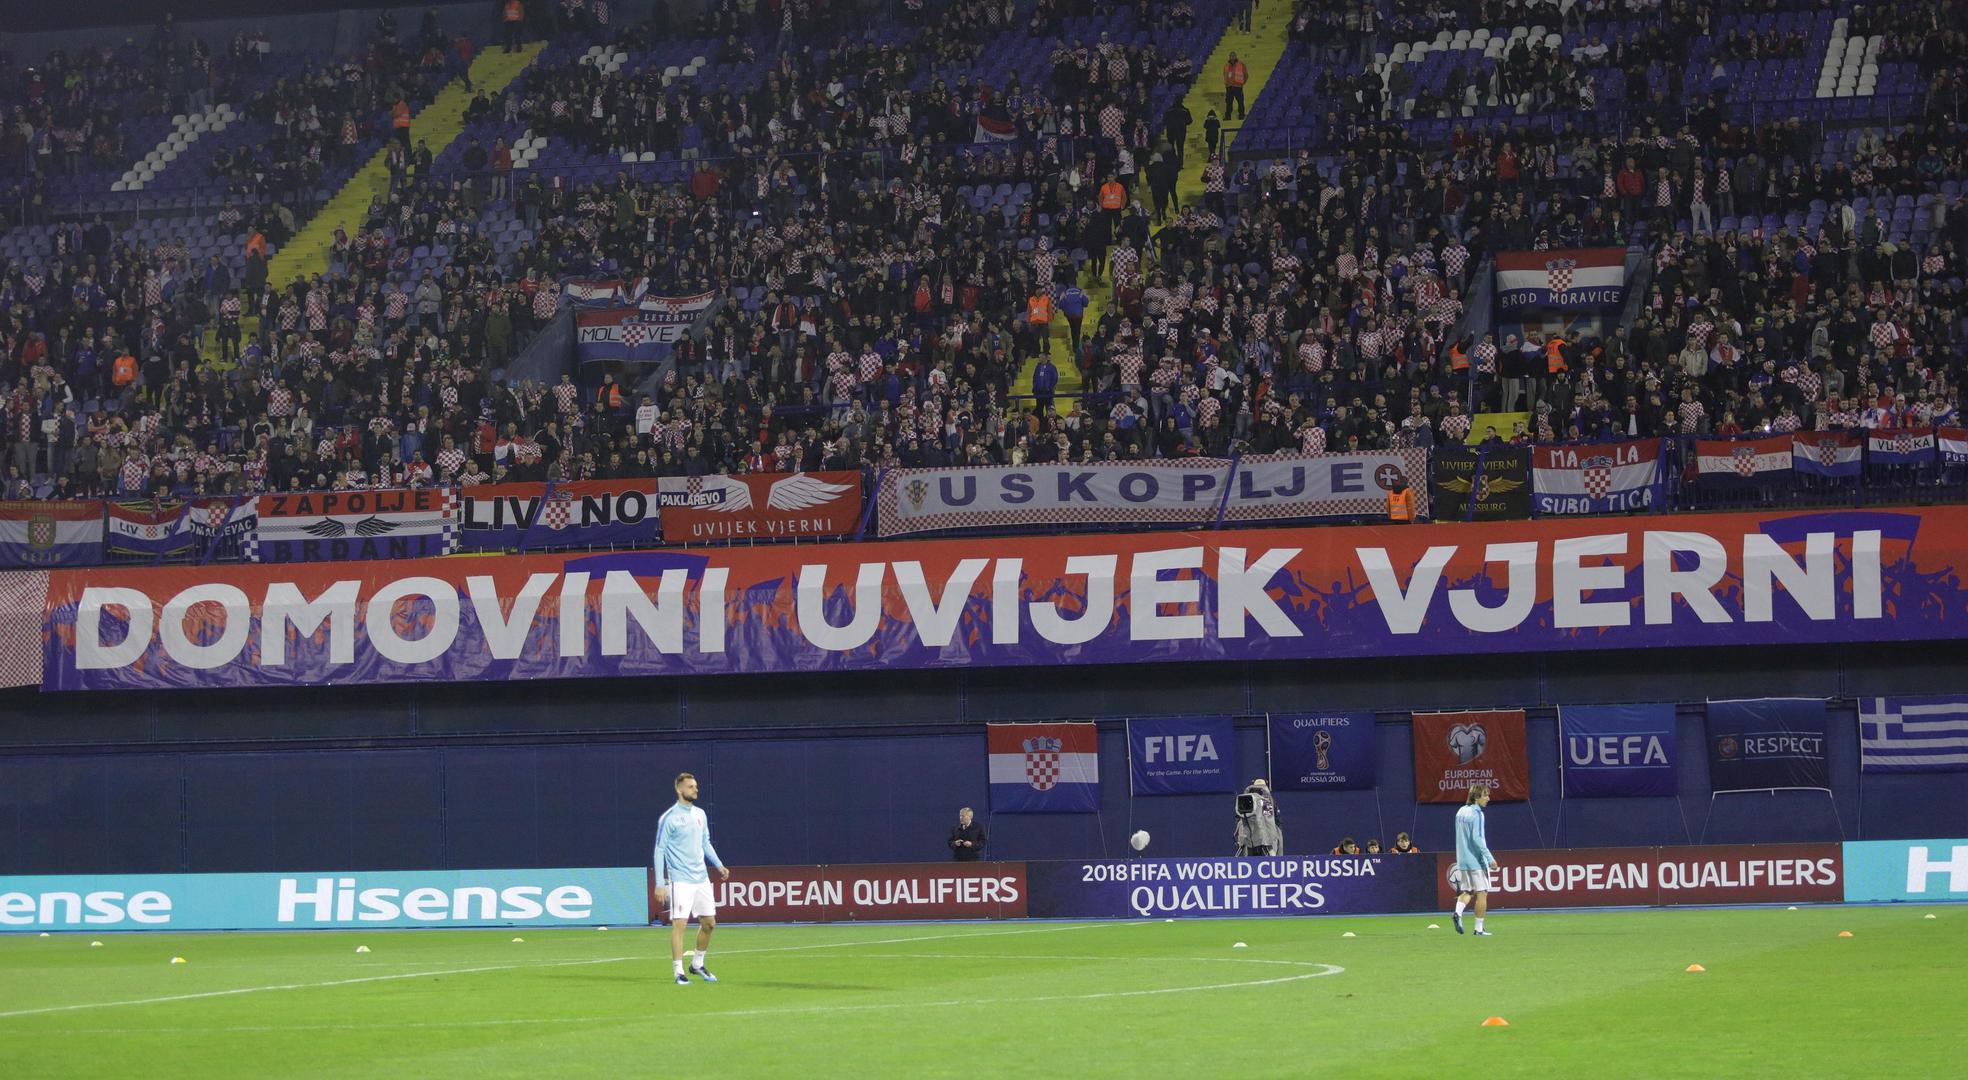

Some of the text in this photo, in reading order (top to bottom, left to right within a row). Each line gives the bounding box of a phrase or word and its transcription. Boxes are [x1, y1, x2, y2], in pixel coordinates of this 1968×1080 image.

[1502, 290, 1620, 308] BROD MORAVICE
[939, 462, 1364, 507] USKOPLJE
[271, 491, 430, 516] ZAPOLJE
[660, 491, 720, 506] PAKLAREVO
[693, 518, 832, 537] UVIJEK VJERNI
[76, 530, 1882, 669] DOMOVINI UVIJEK VJERNI
[1293, 717, 1350, 729] QUALIFIERS
[1144, 734, 1219, 763] FIFA
[1569, 735, 1669, 766] UEFA
[1744, 737, 1823, 754] RESPECT
[1301, 775, 1346, 783] RUSSIA 2018
[1444, 769, 1493, 779] EUROPEAN
[1082, 864, 1128, 882] 2018
[1130, 862, 1172, 881] FIFA
[1175, 861, 1253, 881] WORLD
[1257, 860, 1298, 879] CUP
[1487, 858, 1837, 893] EUROPEAN QUALIFIERS
[278, 878, 593, 923] Hisense
[716, 876, 1019, 907] UROPEAN QUALIFIERS
[1131, 882, 1325, 916] QUALIFIERS
[0, 889, 172, 924] ense
